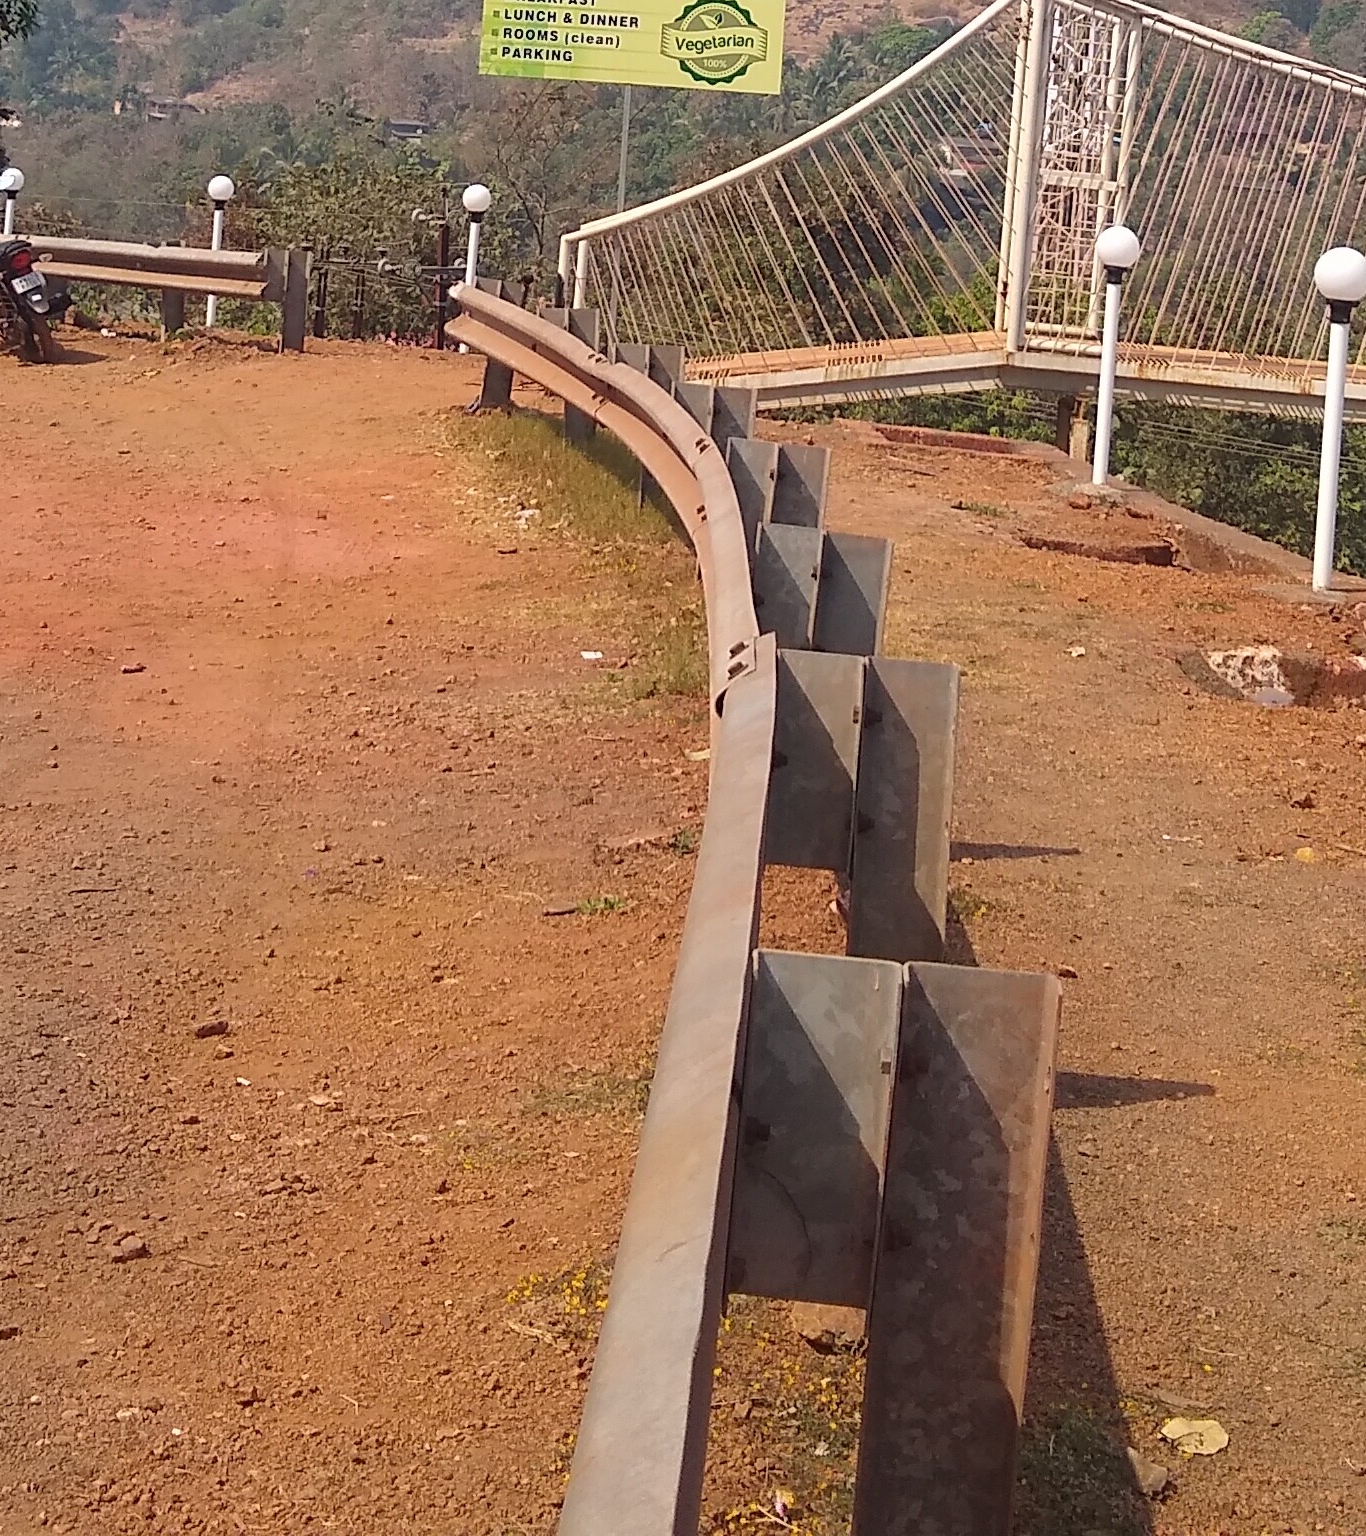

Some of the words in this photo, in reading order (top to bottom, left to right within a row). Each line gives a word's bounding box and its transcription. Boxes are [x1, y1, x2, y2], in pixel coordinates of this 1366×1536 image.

[504, 8, 557, 23] LUNCH
[563, 12, 573, 24] &
[580, 13, 639, 28] DINNER
[503, 27, 559, 42] ROOMS
[564, 32, 621, 48] (clean)
[675, 34, 754, 54] Vegetarian
[501, 46, 573, 62] PARKING
[702, 58, 727, 68] 100%
